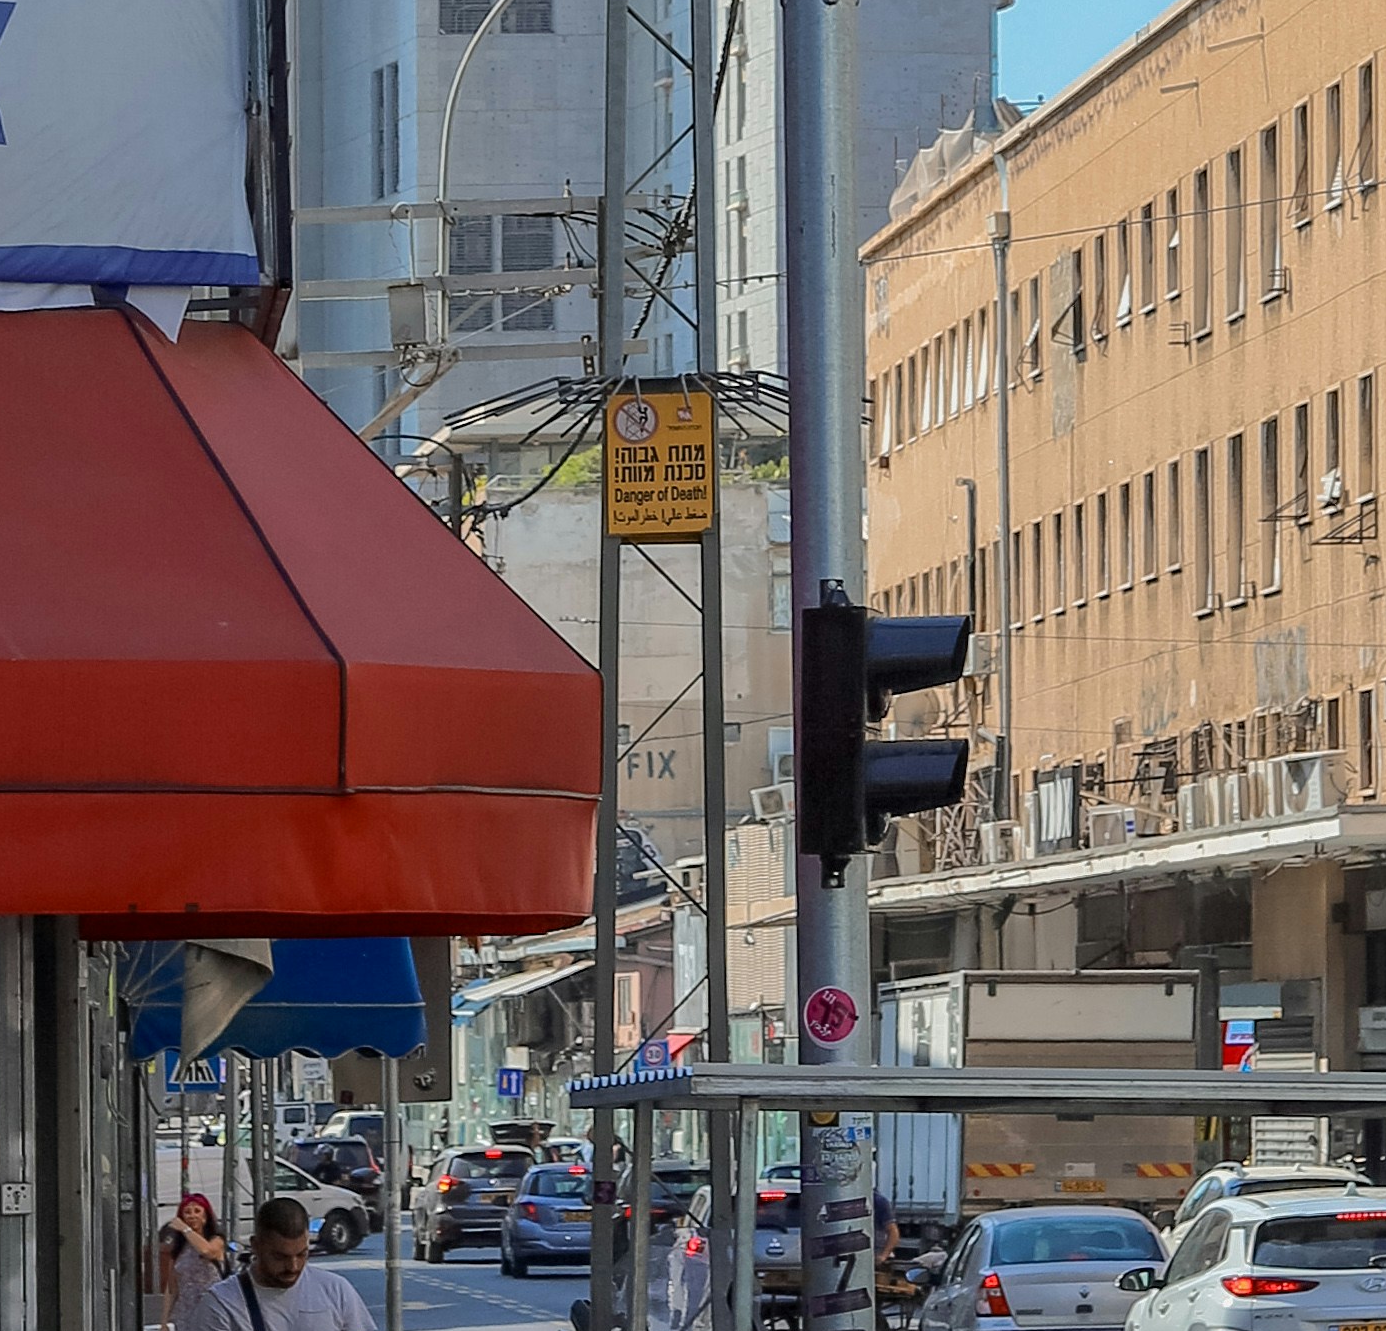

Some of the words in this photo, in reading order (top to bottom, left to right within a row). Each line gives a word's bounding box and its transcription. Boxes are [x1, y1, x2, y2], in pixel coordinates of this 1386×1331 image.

[614, 446, 660, 464] גבוה!
[668, 444, 705, 462] מתח
[614, 465, 655, 483] מוות!
[663, 464, 706, 482] סכנת
[614, 488, 655, 506] Danger
[657, 486, 669, 501] of
[671, 485, 707, 501] Death!
[628, 749, 676, 780] FIX
